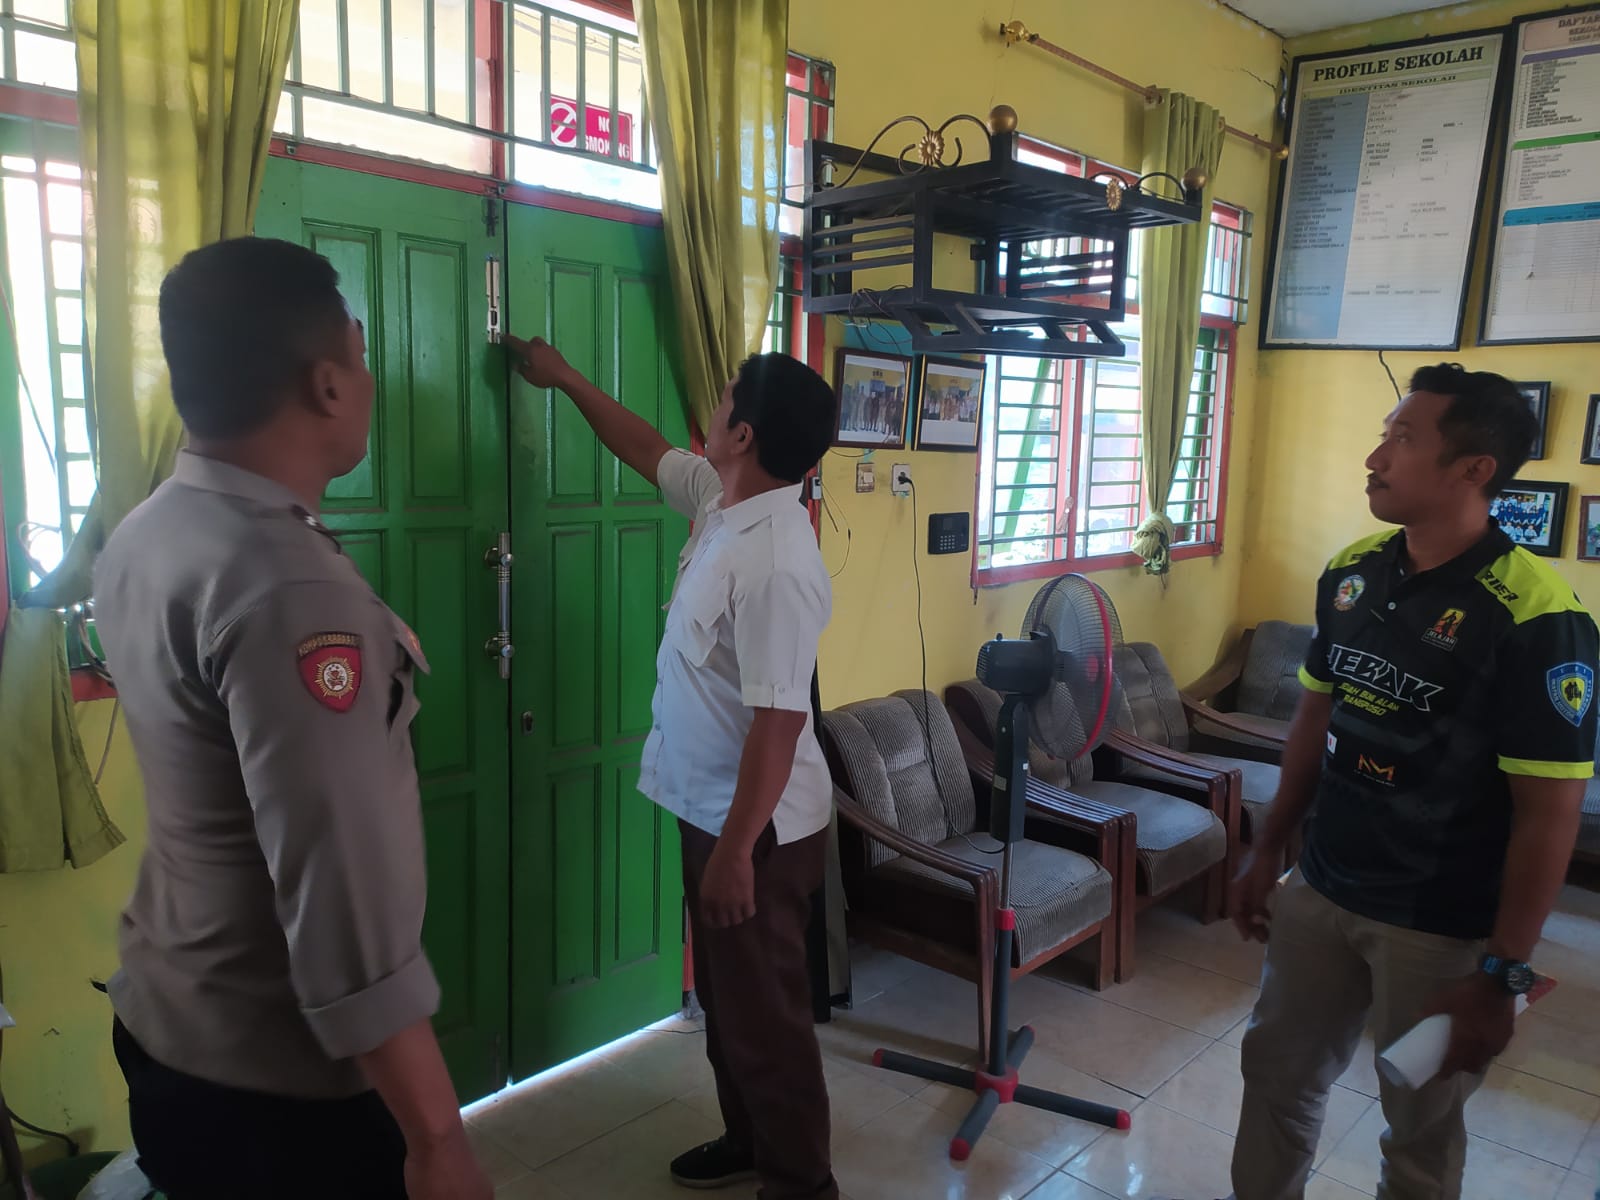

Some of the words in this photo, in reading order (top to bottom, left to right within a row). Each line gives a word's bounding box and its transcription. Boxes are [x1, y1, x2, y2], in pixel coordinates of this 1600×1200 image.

[1313, 59, 1389, 82] PROFILE
[1394, 46, 1484, 71] SEKOLAH
[1339, 82, 1398, 94] IDENTITAS
[1401, 75, 1457, 87] SEKOLAH
[585, 135, 630, 158] SMOKNG
